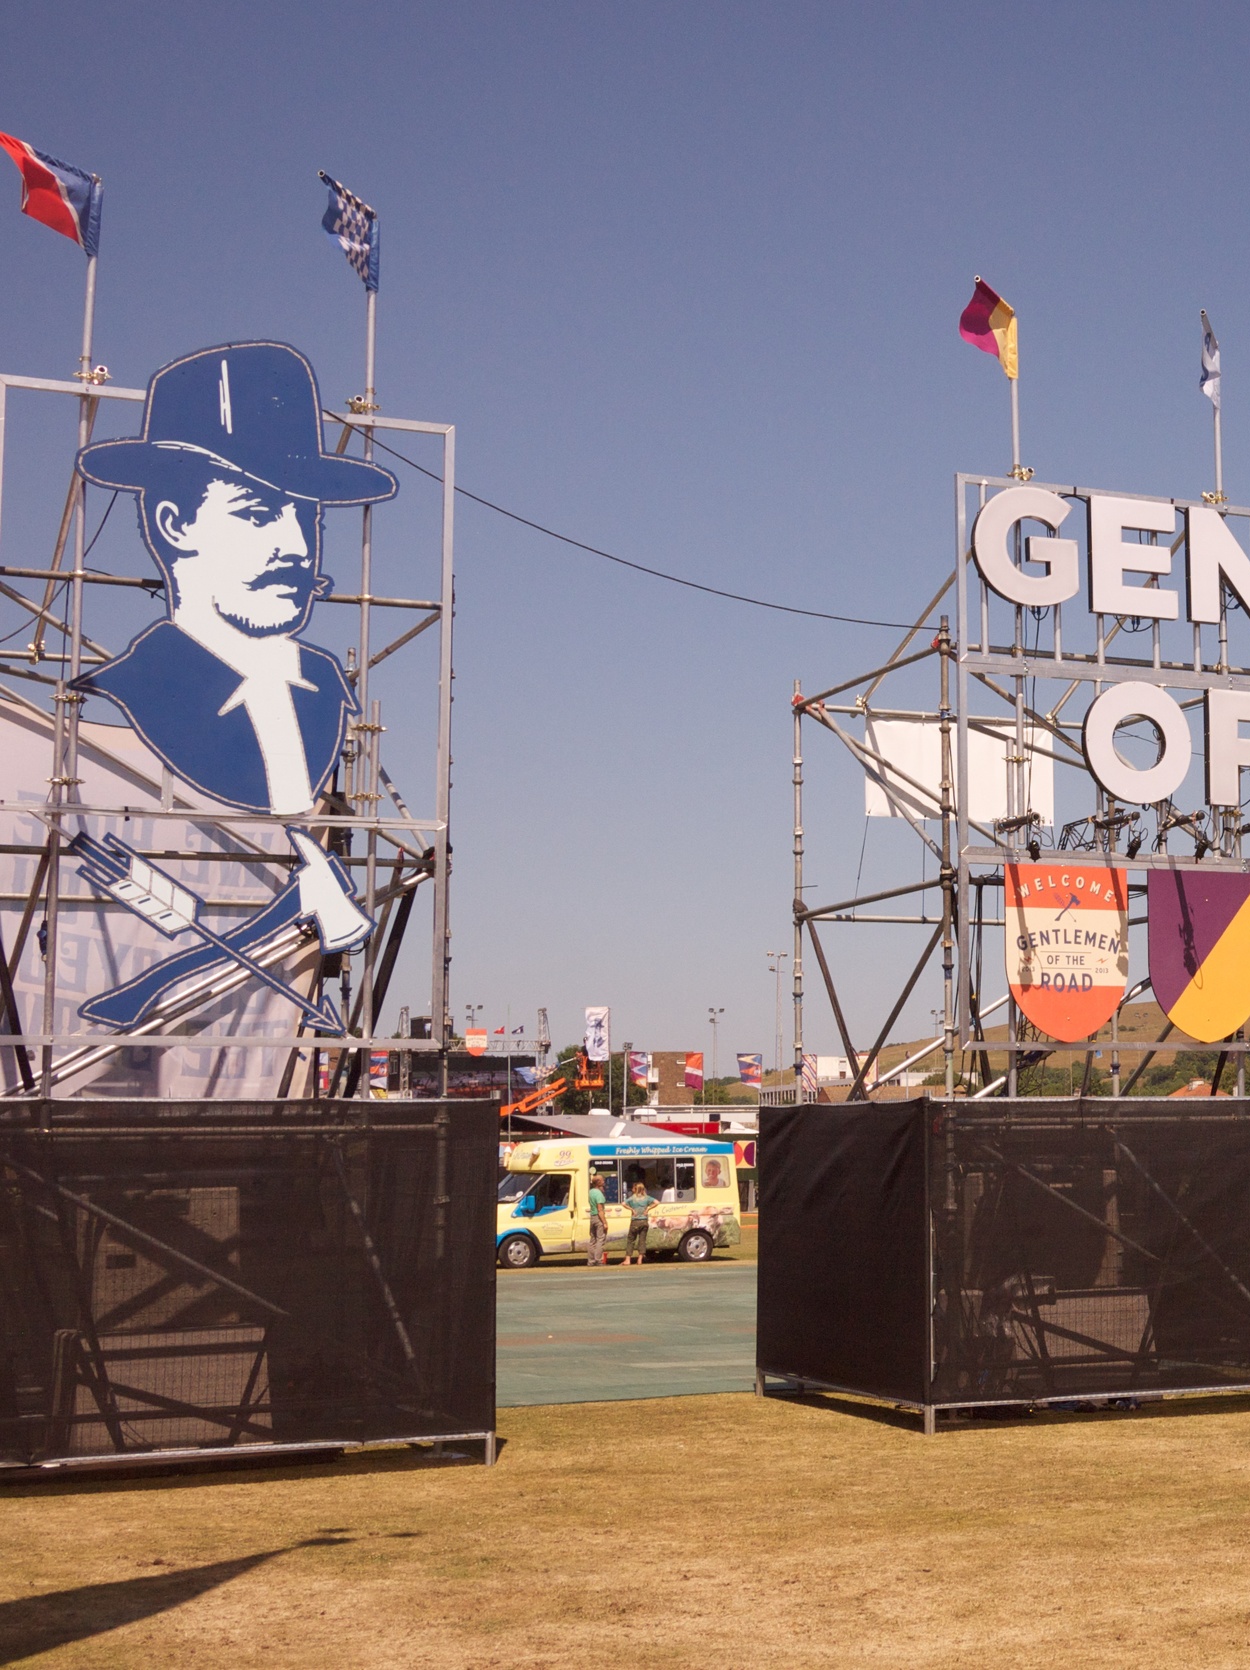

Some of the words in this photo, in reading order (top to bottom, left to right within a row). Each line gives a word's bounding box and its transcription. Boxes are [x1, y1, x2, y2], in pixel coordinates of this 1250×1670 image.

[1017, 873, 1115, 902] WELCOME
[1016, 928, 1121, 955] GENTLEMEN
[1047, 954, 1060, 966] OF
[1066, 954, 1085, 966] THE
[1040, 972, 1094, 993] ROAD
[559, 1150, 572, 1159] 99
[641, 1146, 671, 1154] Whipped
